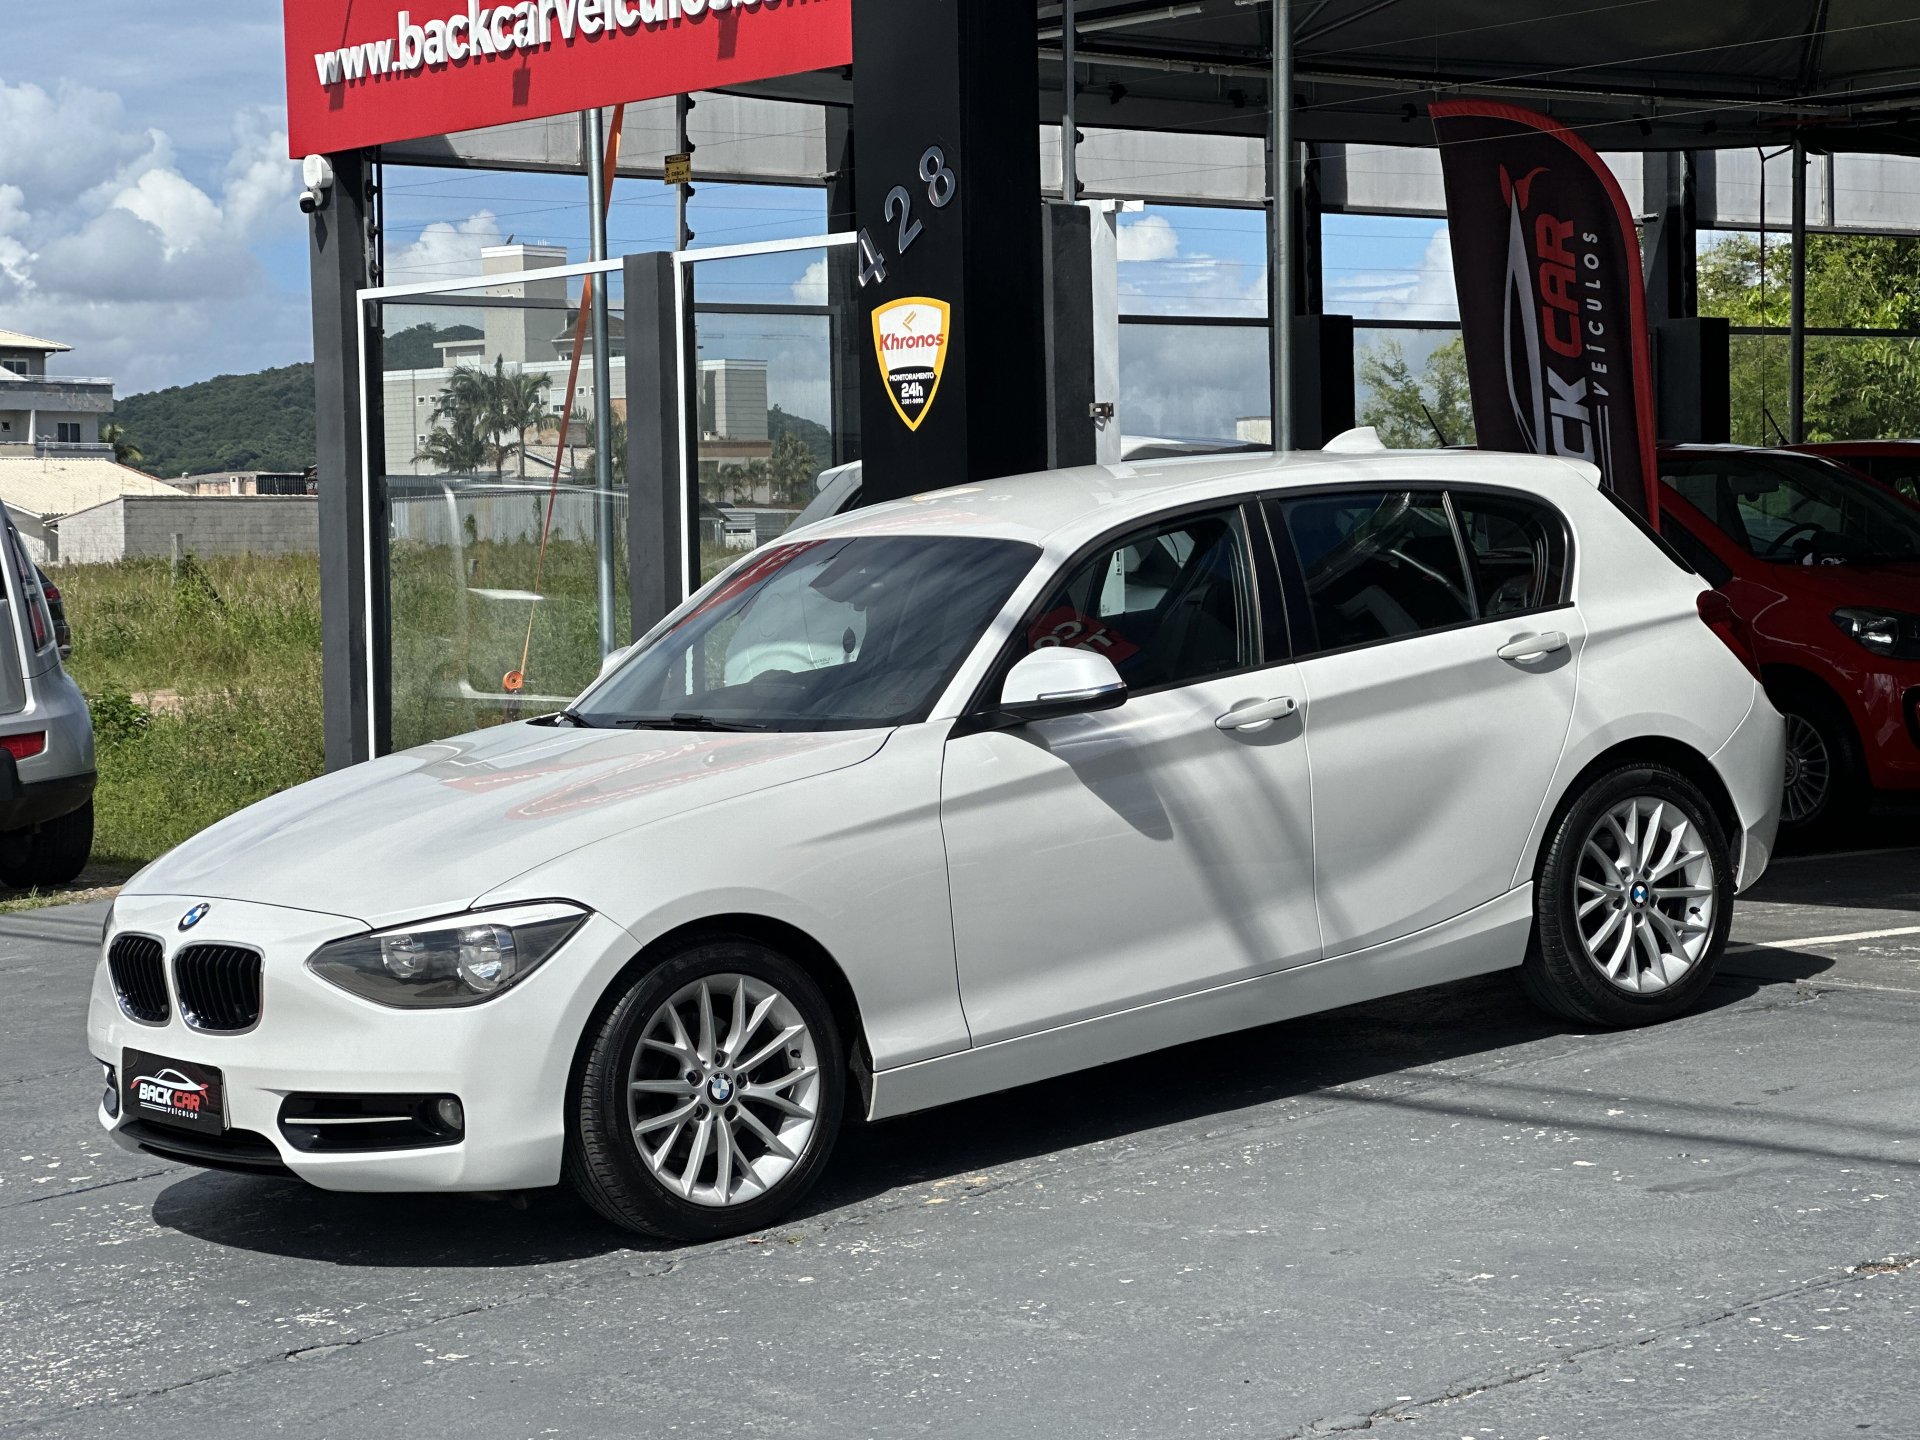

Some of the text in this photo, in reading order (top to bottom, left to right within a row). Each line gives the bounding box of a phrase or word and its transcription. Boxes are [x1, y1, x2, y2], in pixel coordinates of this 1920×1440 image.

[859, 146, 956, 288] 428
[879, 332, 945, 351] Khronos
[1535, 213, 1596, 463] CK CAR
[889, 371, 935, 381] MONITORAMENTO
[901, 381, 924, 398] 24h
[139, 1082, 200, 1111] BACK CAR
